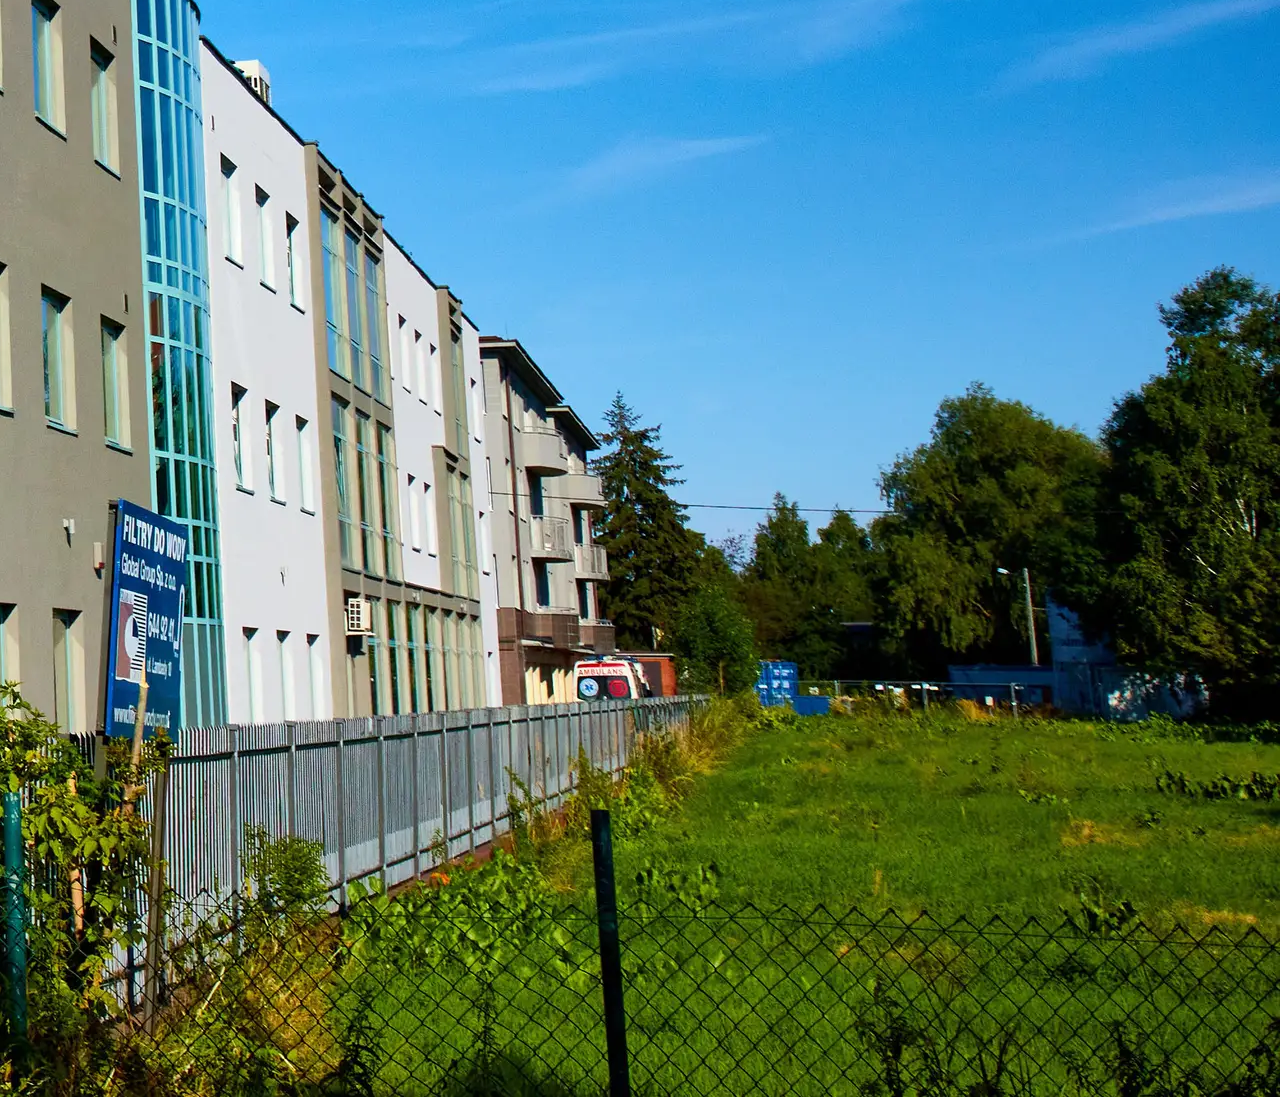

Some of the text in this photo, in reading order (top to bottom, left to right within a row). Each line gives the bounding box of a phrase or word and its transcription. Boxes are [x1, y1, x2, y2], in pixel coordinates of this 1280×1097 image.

[123, 514, 186, 563] FILTRY DO WODY
[121, 552, 140, 578] Global
[140, 558, 156, 589] Group
[164, 573, 169, 589] z
[147, 612, 160, 638] 644
[160, 615, 168, 641] 92
[578, 668, 624, 676] AMBULANS
